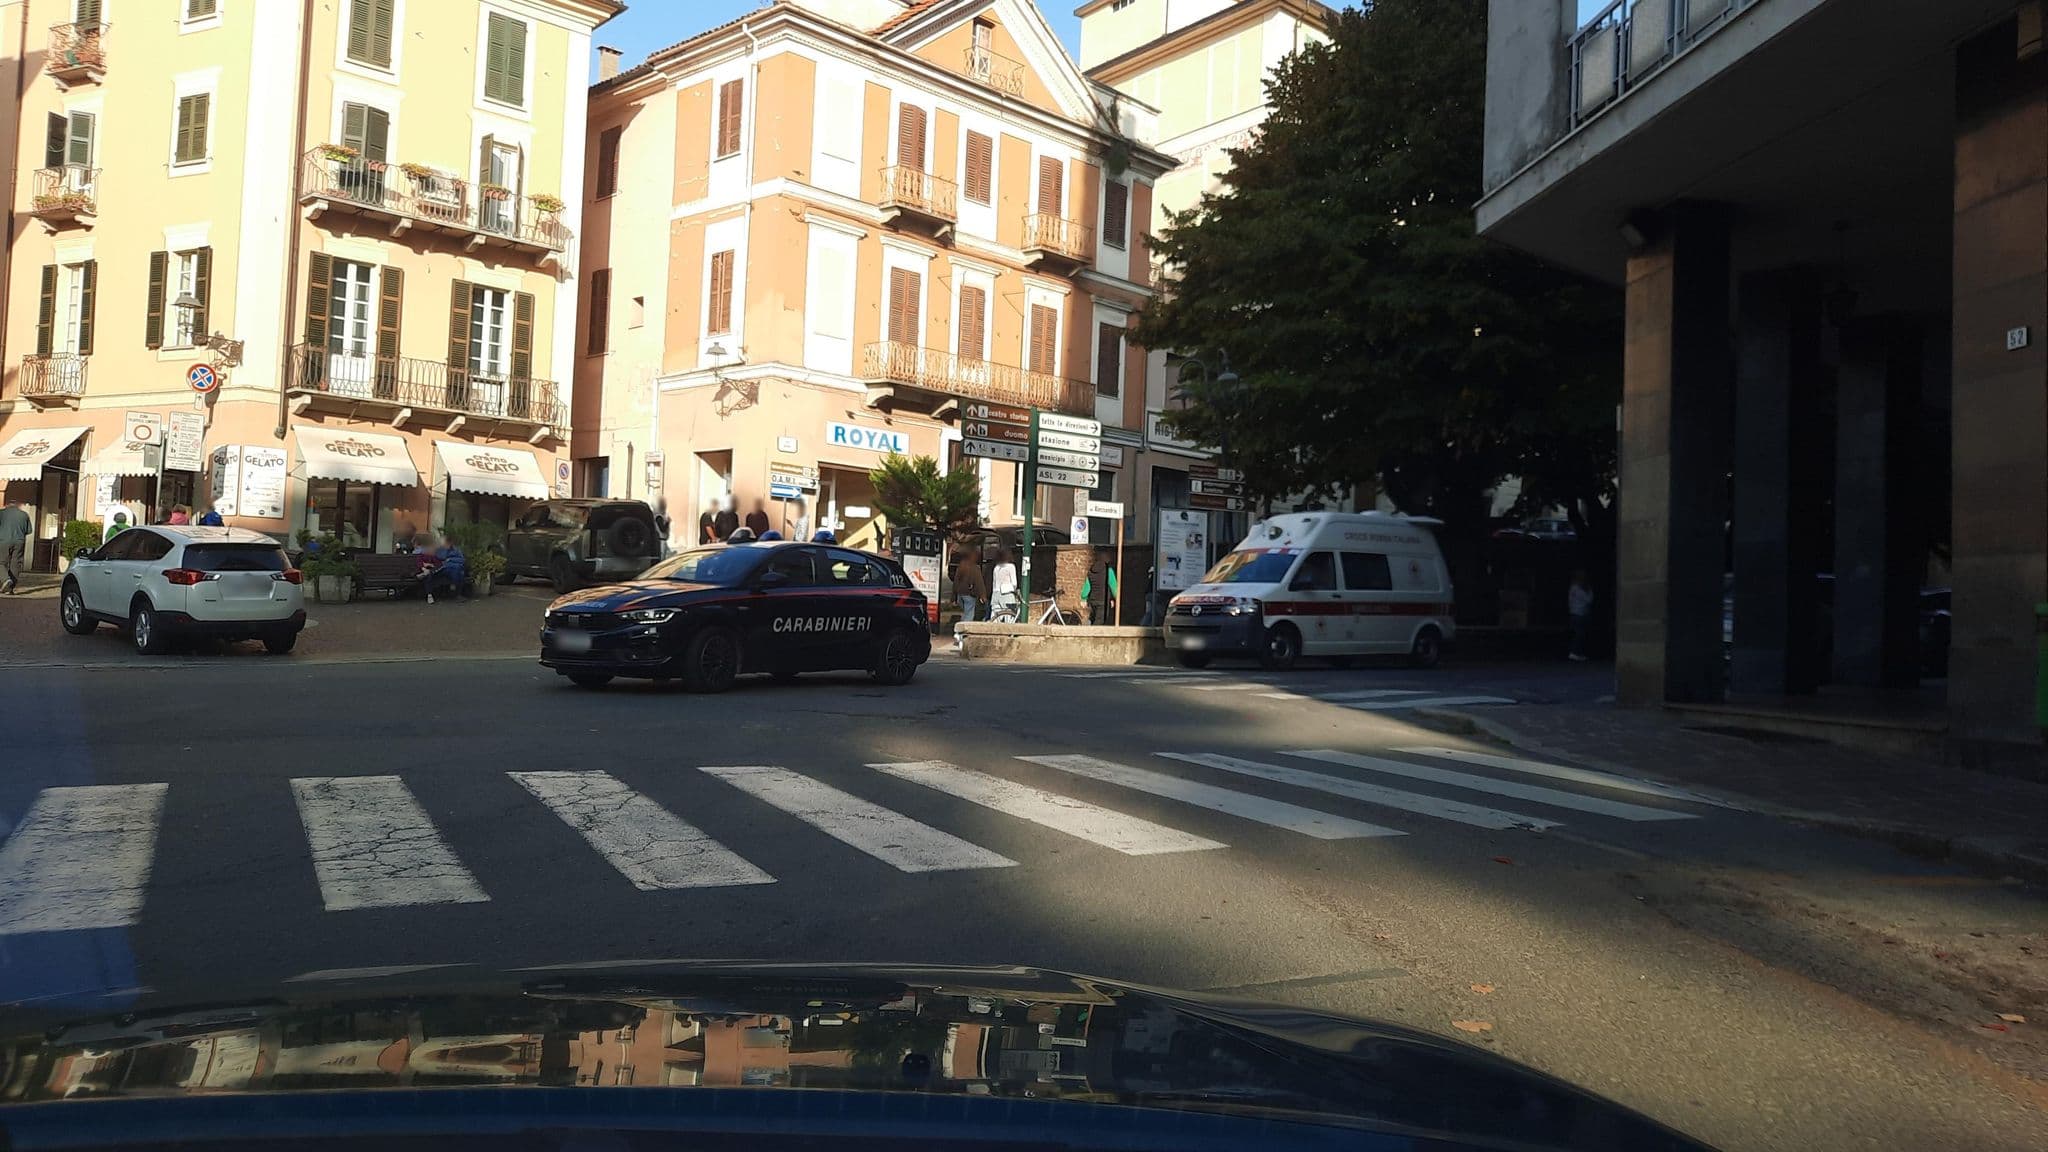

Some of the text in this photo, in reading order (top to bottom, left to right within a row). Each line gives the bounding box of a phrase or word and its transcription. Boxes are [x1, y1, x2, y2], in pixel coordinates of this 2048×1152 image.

[834, 425, 903, 451] ROYAL
[1004, 430, 1028, 439] duomo
[1041, 436, 1070, 445] stazione
[325, 443, 385, 458] GELATO
[213, 454, 238, 466] GELATO
[245, 455, 284, 467] GELATO
[1040, 454, 1066, 463] municipio
[465, 458, 519, 472] GELATO
[1039, 471, 1067, 481] ASL 22
[890, 574, 905, 585] 112
[773, 616, 871, 632] CARABINIERI
